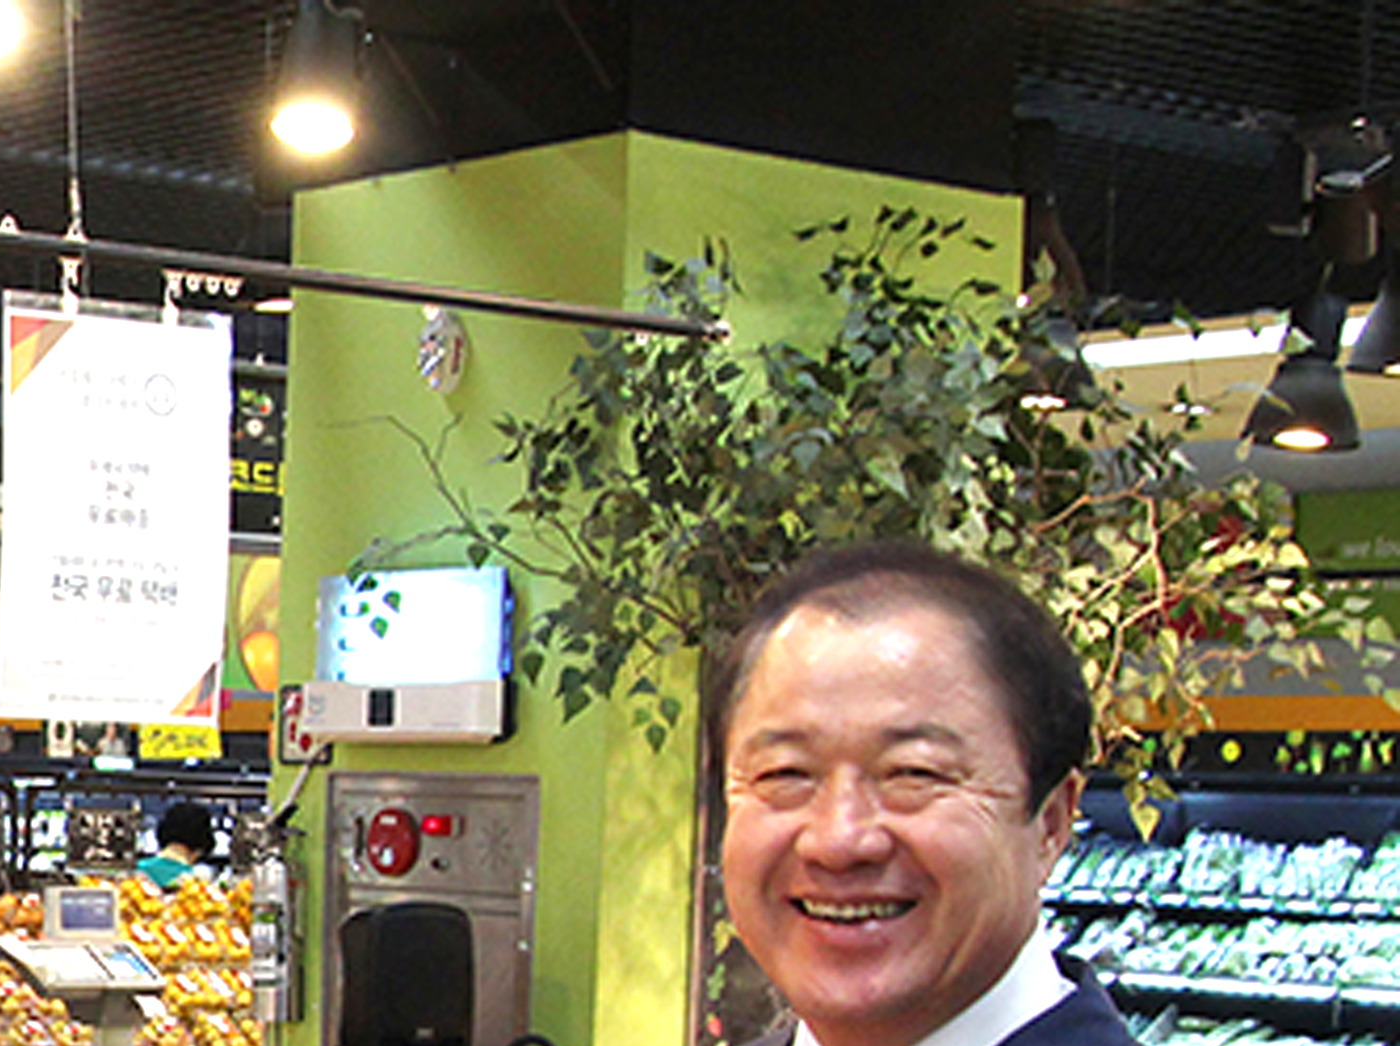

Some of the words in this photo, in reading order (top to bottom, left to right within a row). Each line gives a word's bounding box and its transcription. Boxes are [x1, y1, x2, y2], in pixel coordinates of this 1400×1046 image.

[50, 573, 89, 602] 전국
[96, 575, 133, 605] 무료
[140, 579, 179, 607] 택배
